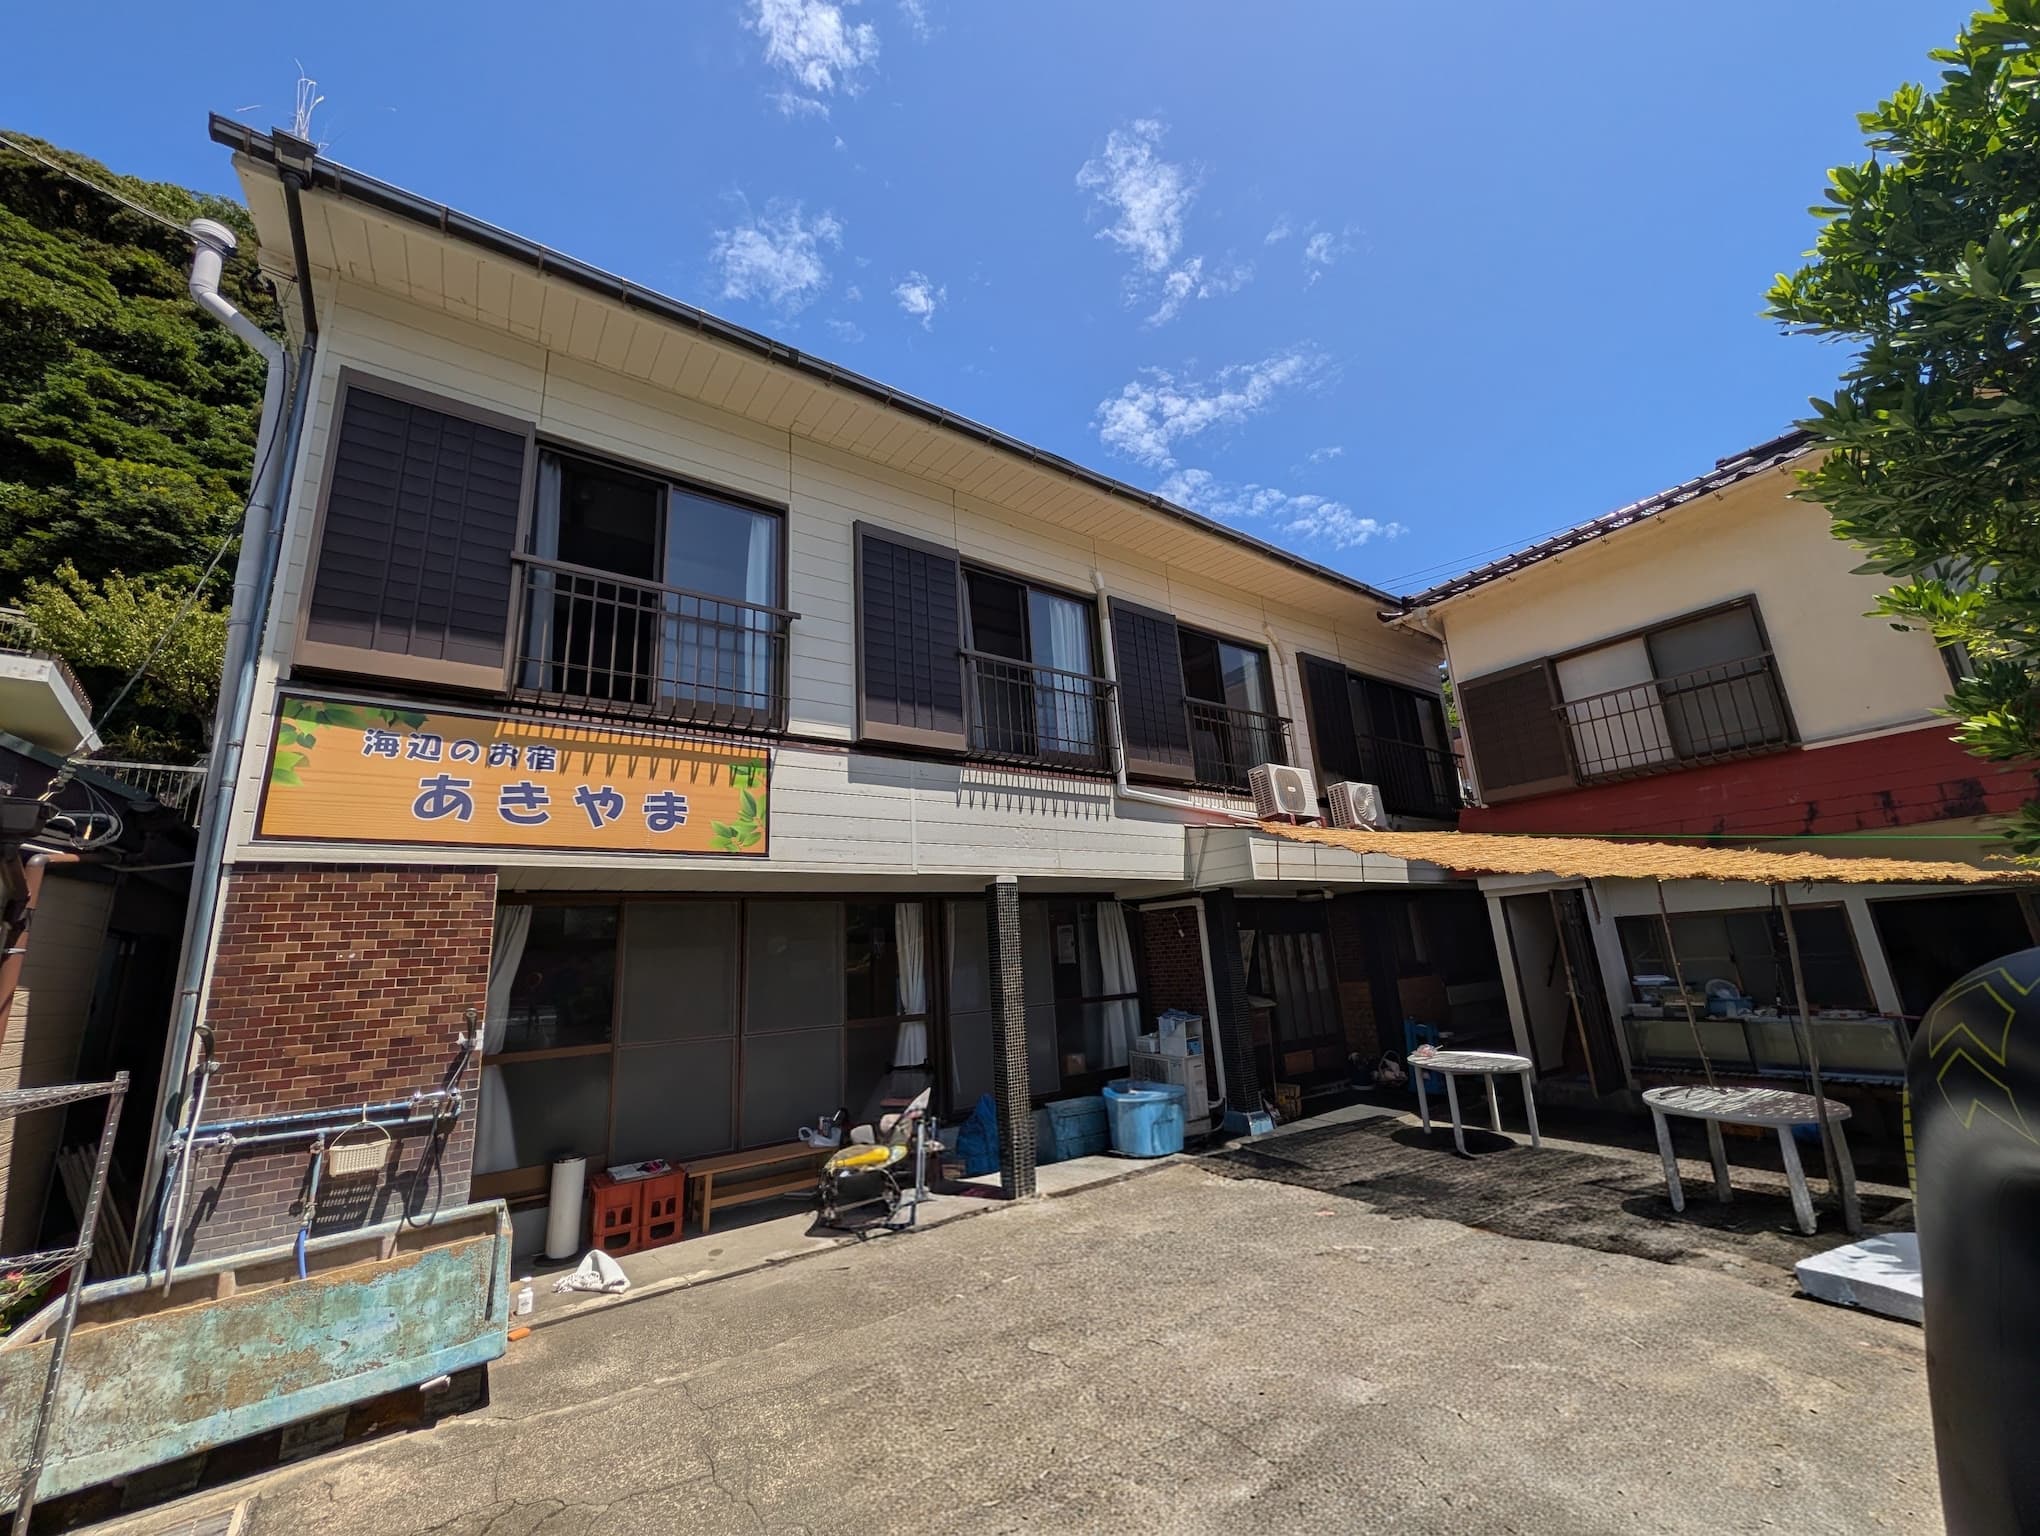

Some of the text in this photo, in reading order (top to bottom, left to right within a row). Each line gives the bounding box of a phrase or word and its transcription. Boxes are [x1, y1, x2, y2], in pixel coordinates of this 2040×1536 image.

[362, 728, 559, 772] 海辺のお宿
[412, 773, 690, 833] あきやま
